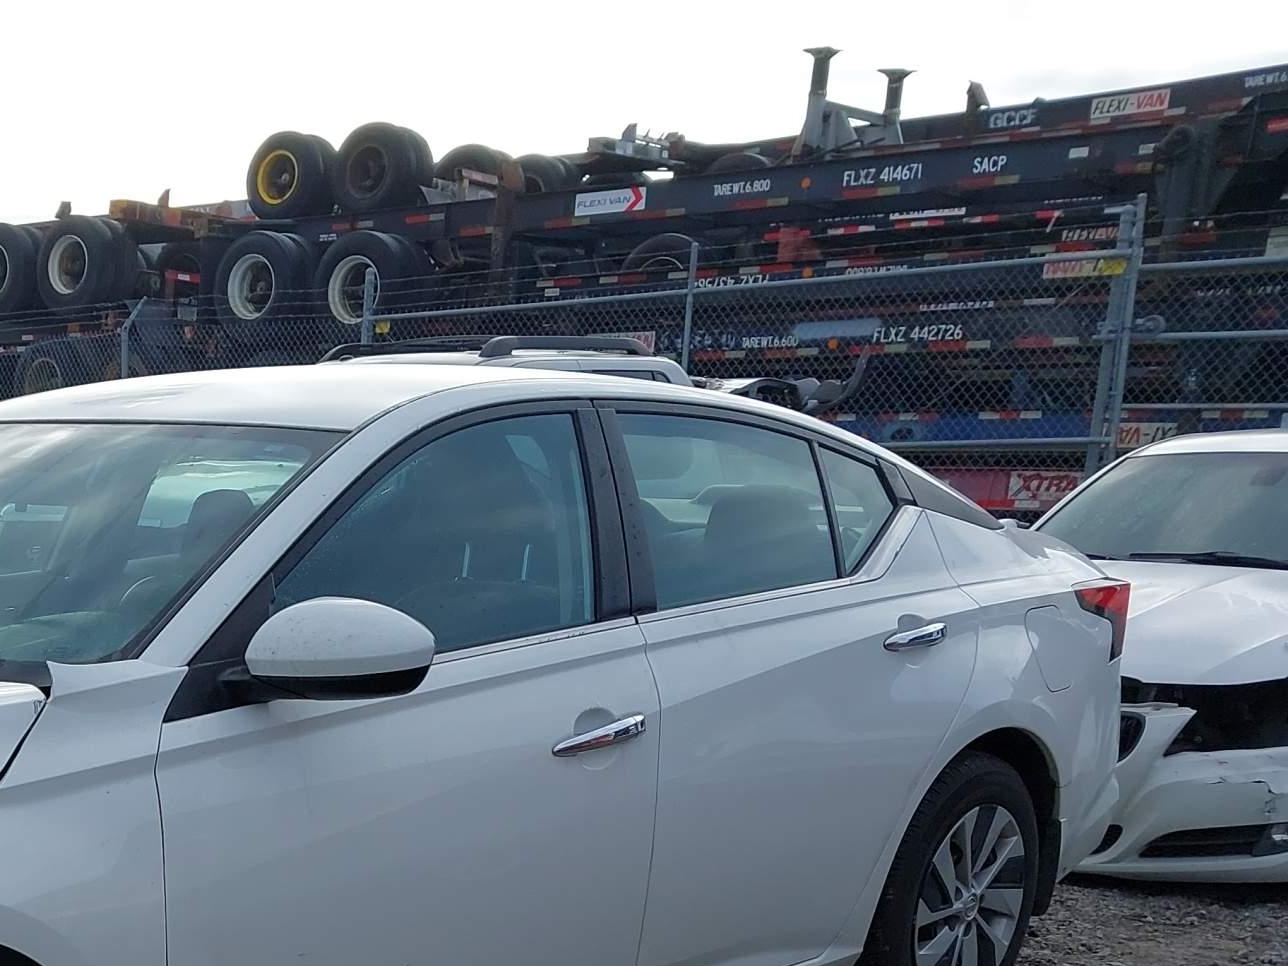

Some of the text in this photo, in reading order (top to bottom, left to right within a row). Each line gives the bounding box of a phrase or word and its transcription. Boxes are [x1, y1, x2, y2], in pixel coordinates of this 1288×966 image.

[1093, 91, 1168, 115] FLEXI-VAN
[972, 155, 1007, 174] SACP
[843, 163, 923, 187] FLXZ 414671
[609, 195, 632, 206] VAN
[873, 324, 963, 343] FLXZ 442726
